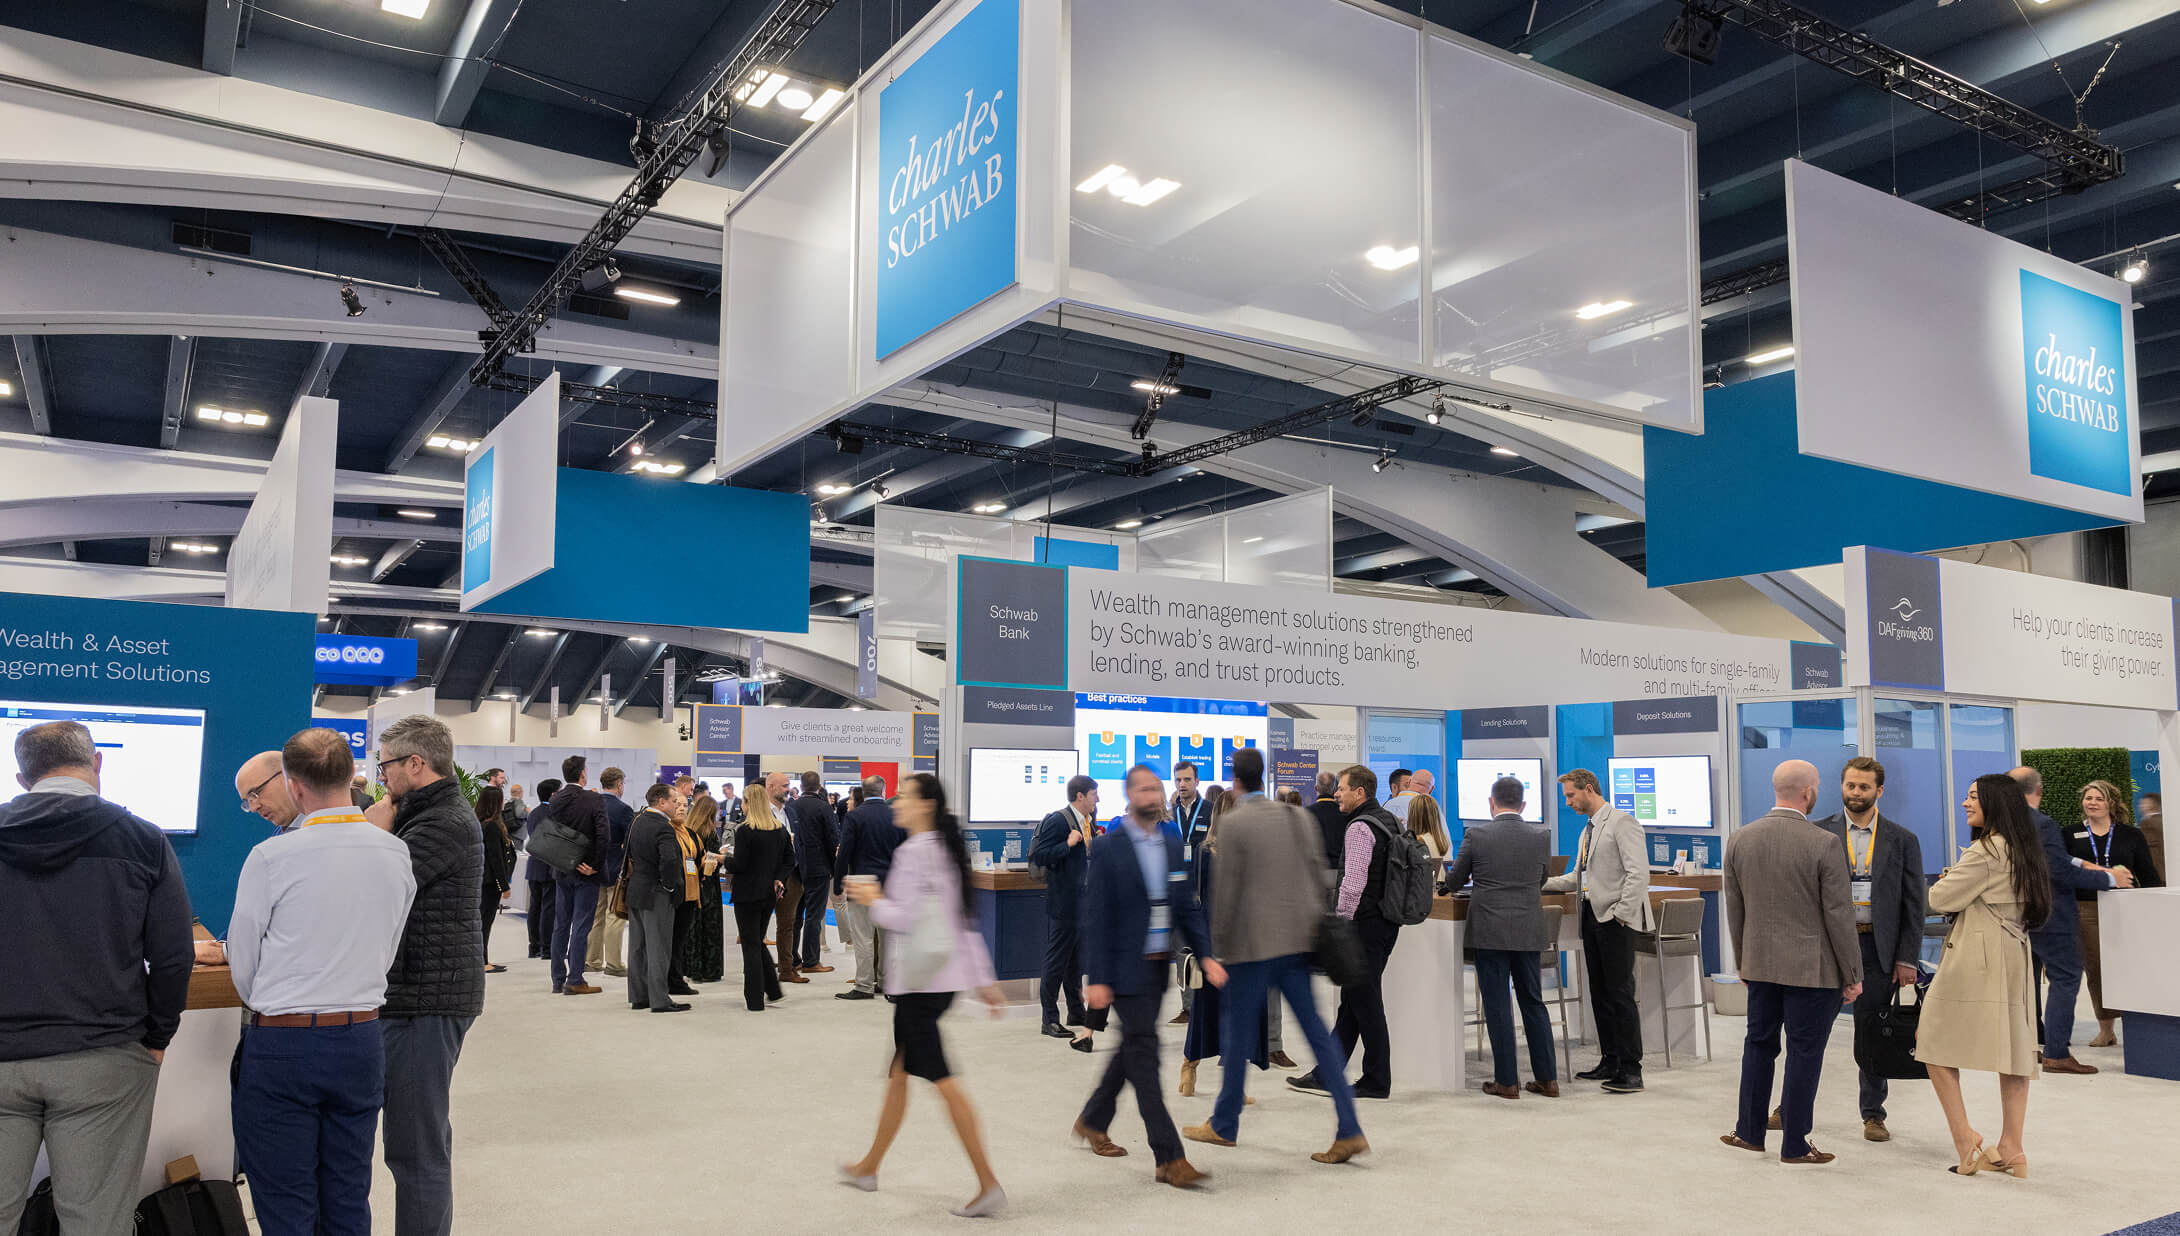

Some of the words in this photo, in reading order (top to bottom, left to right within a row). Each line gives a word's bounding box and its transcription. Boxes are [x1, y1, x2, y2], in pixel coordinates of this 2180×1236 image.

[889, 88, 1003, 215] charles
[888, 153, 1003, 268] SCHWAB
[2035, 333, 2116, 396] charles
[2036, 384, 2119, 433] SCHWAB
[990, 605, 1038, 622] Schwab
[1090, 589, 1160, 616] Wealth
[1168, 600, 1288, 628] management
[1292, 610, 1368, 634] solutions
[1372, 620, 1473, 643] strengthened
[999, 625, 1030, 640] Bank
[2012, 607, 2042, 634] Help
[2046, 616, 2073, 640] your
[2076, 617, 2114, 643] clients
[2117, 622, 2163, 649] increase
[0, 628, 73, 650] Wealth
[83, 633, 99, 652] &
[106, 635, 170, 655] Asset
[1091, 620, 1114, 647] by
[1120, 622, 1212, 650] Schwab's
[1218, 634, 1349, 664] award-winning
[1354, 643, 1420, 669] banking,
[342, 646, 384, 664] QQQ
[1580, 648, 1629, 669] Modern
[1633, 653, 1687, 674] solutions
[1691, 657, 1707, 674] for
[1710, 660, 1780, 684] single-family
[2061, 648, 2088, 667] their
[2092, 651, 2126, 679] giving
[2128, 659, 2165, 679] power.
[106, 661, 210, 684] Solutions
[1091, 652, 1168, 681] lending,
[1175, 659, 1209, 678] and
[1216, 662, 1258, 682] trust
[1265, 664, 1344, 688] products.
[1805, 667, 1829, 678] Schwab
[1087, 693, 1107, 702] Best
[1109, 694, 1148, 704] practices
[1644, 679, 1667, 695] and
[987, 701, 1015, 712] Pledged
[1016, 702, 1038, 711] Assets
[1039, 703, 1053, 711] Line
[1636, 712, 1660, 722] Deposit
[1661, 711, 1692, 720] Solutions
[781, 721, 801, 730] Give
[803, 722, 832, 732] clients
[841, 724, 864, 734] great
[865, 725, 904, 734] welcome
[1480, 719, 1502, 729] Lending
[1503, 718, 1528, 727] Solutions
[778, 733, 797, 742] with
[800, 734, 851, 744] streamlined
